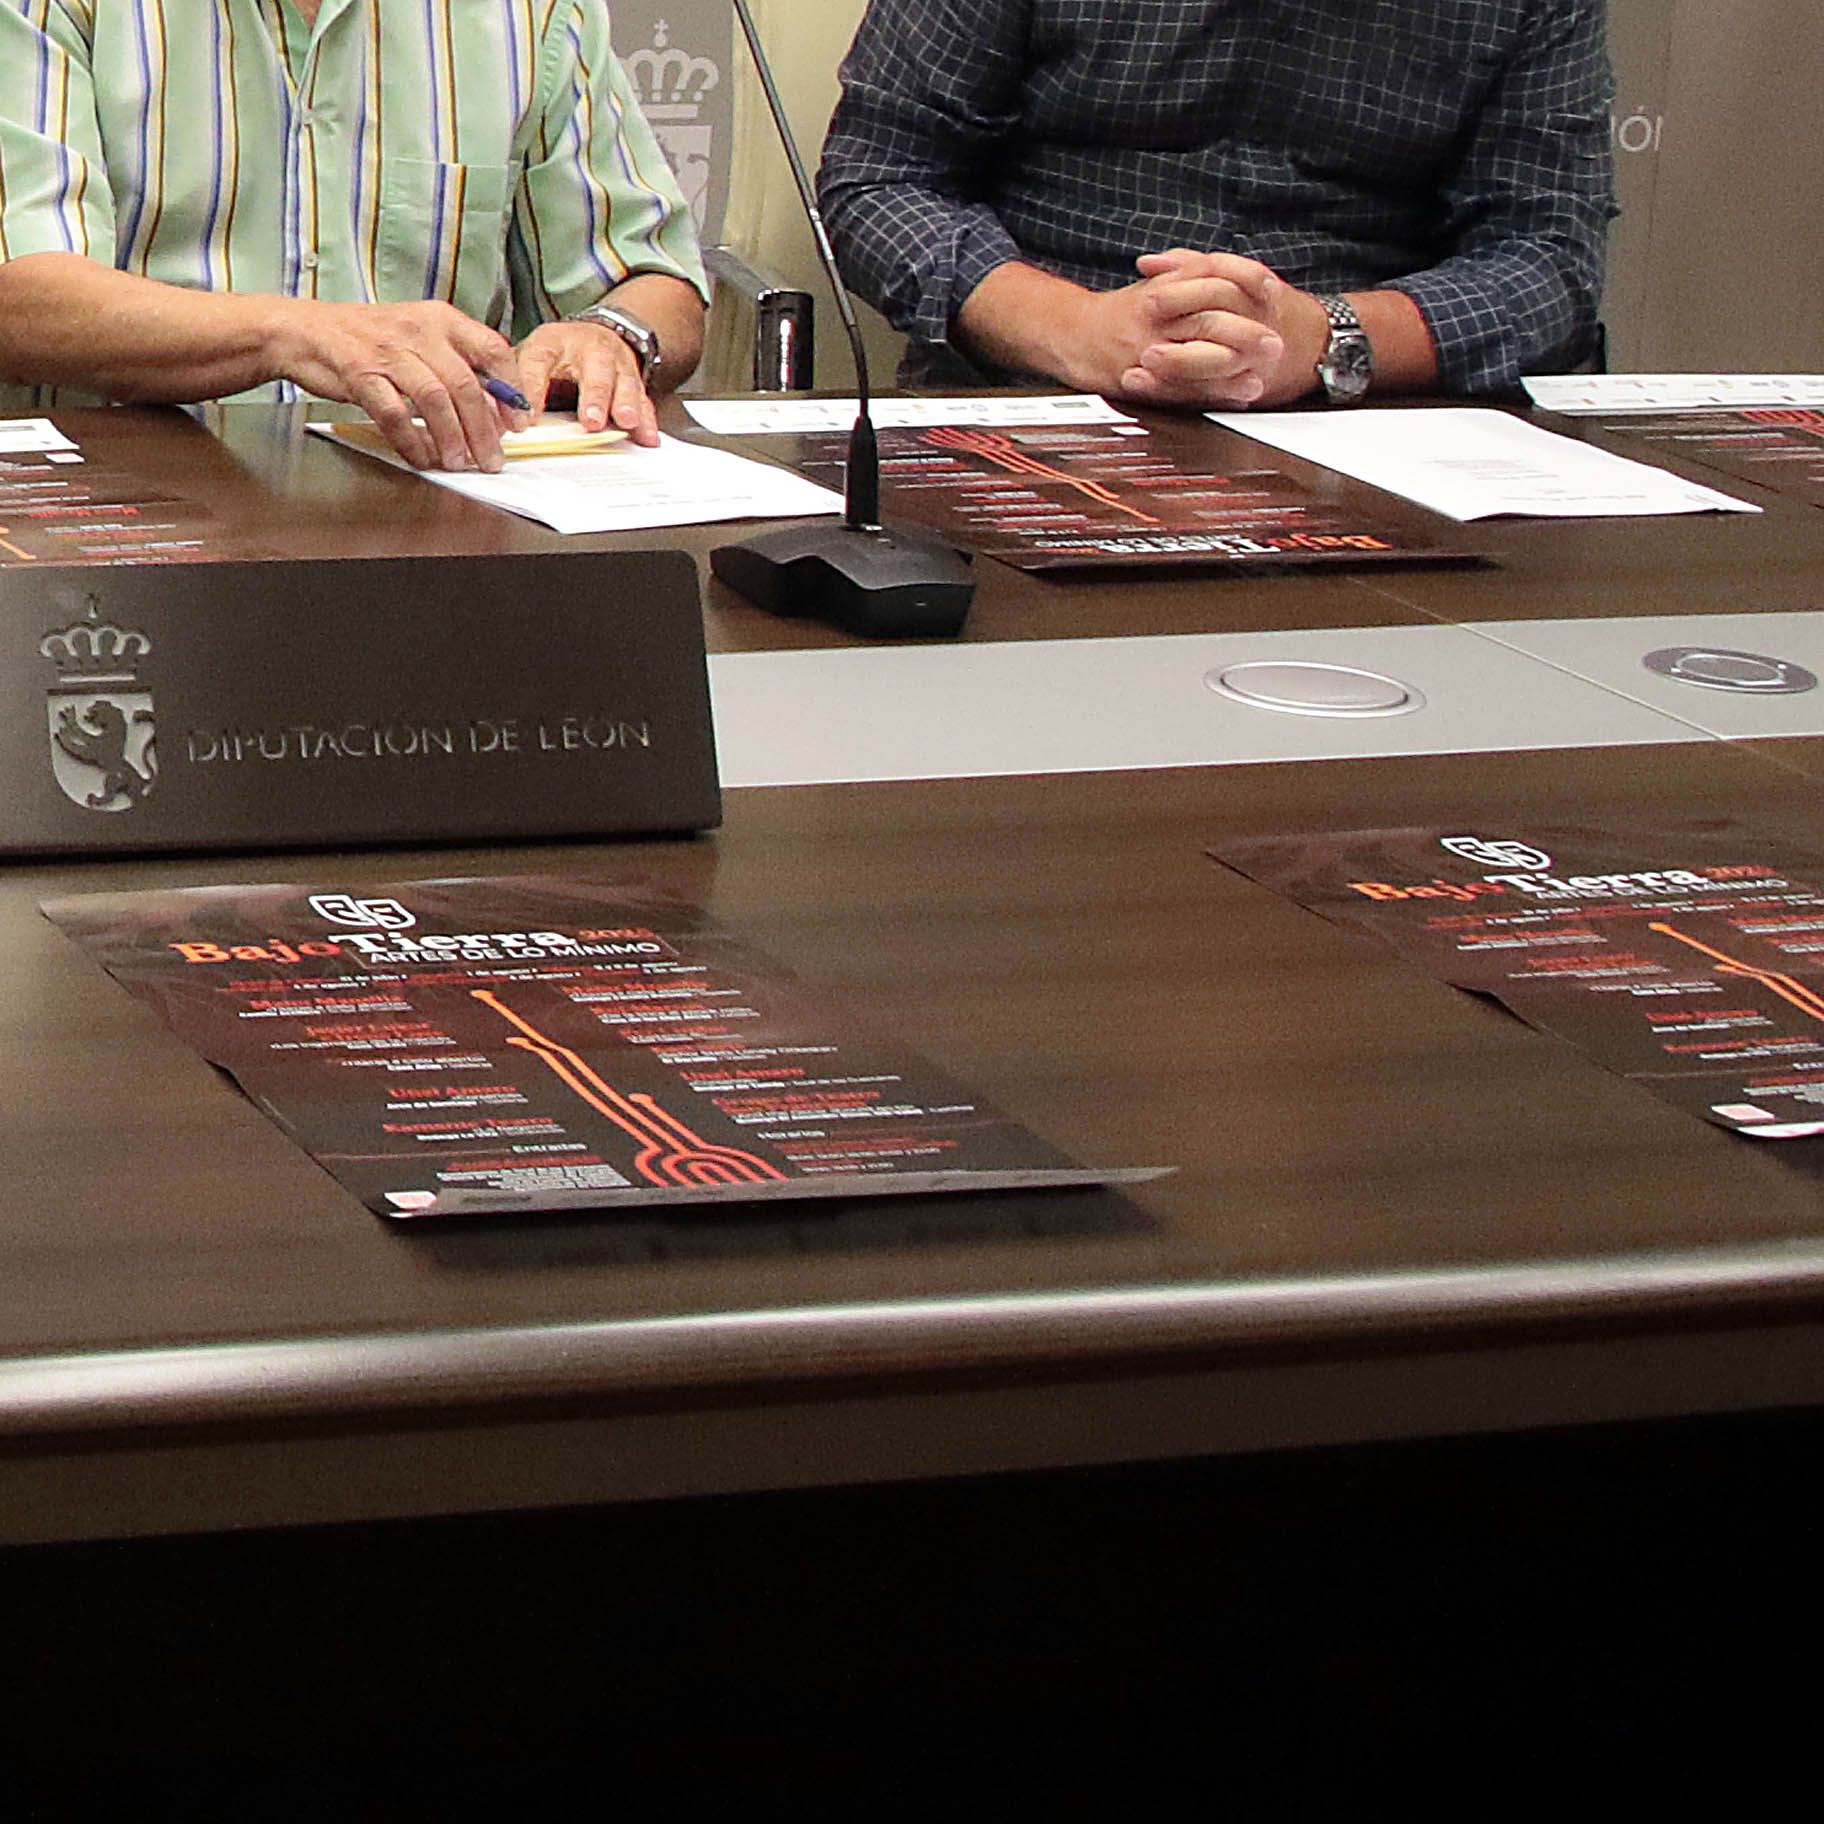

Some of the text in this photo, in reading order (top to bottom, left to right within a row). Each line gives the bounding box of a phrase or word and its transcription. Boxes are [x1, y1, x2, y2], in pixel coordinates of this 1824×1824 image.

[469, 719, 520, 753] DE
[1347, 878, 1505, 902] Bajo
[1483, 869, 1709, 893] Tierra
[168, 938, 342, 964] Bajo
[328, 931, 579, 954] Tierra
[370, 950, 457, 963] ARTES
[461, 948, 505, 961] DE
[508, 946, 545, 959] LO
